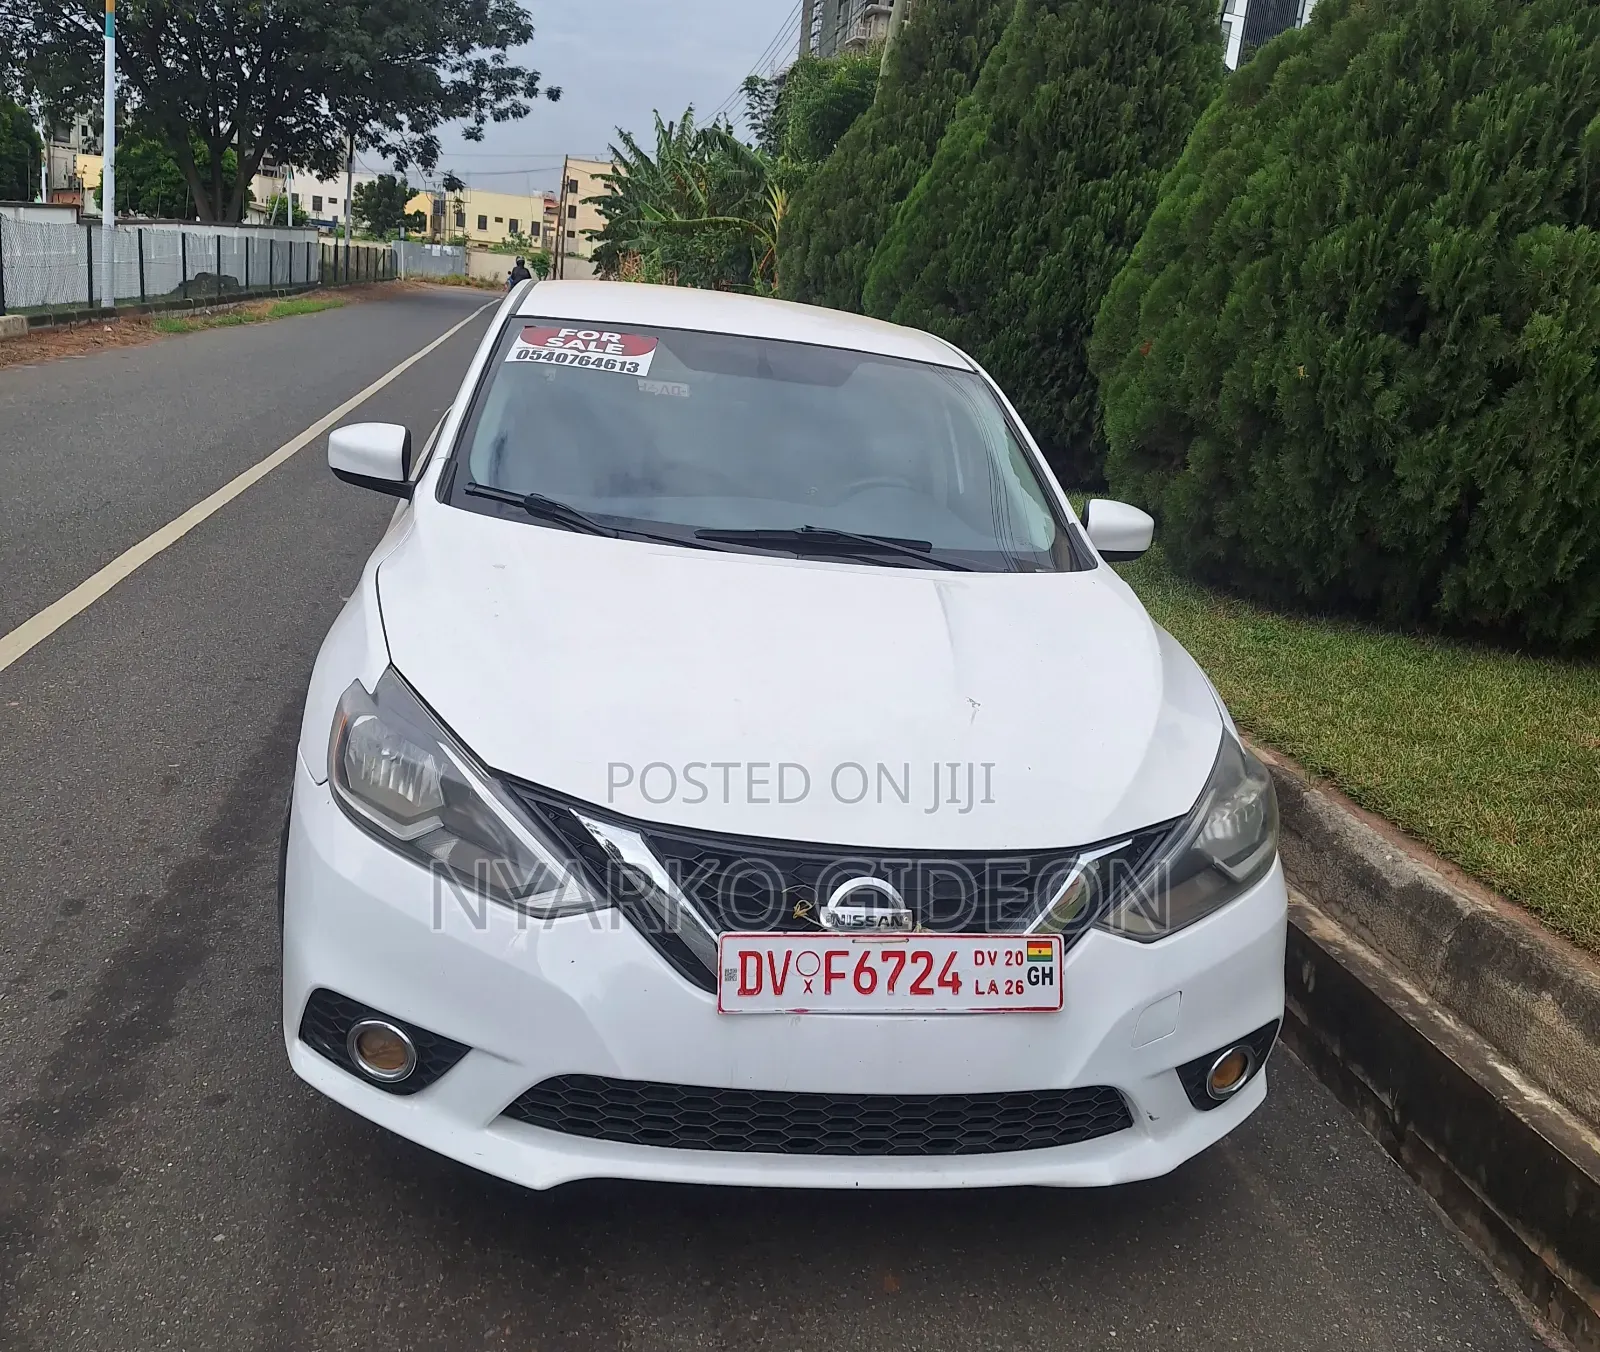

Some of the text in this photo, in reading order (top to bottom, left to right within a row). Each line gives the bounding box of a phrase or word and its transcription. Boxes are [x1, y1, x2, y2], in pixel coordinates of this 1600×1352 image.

[558, 329, 622, 343] FOR
[544, 338, 625, 355] SALE
[515, 350, 640, 374] 0540764613
[831, 914, 903, 927] NISSAN
[974, 950, 1024, 966] DV 20
[737, 950, 792, 996] DV
[1027, 966, 1053, 986] GH
[975, 979, 1024, 995] LA 26
